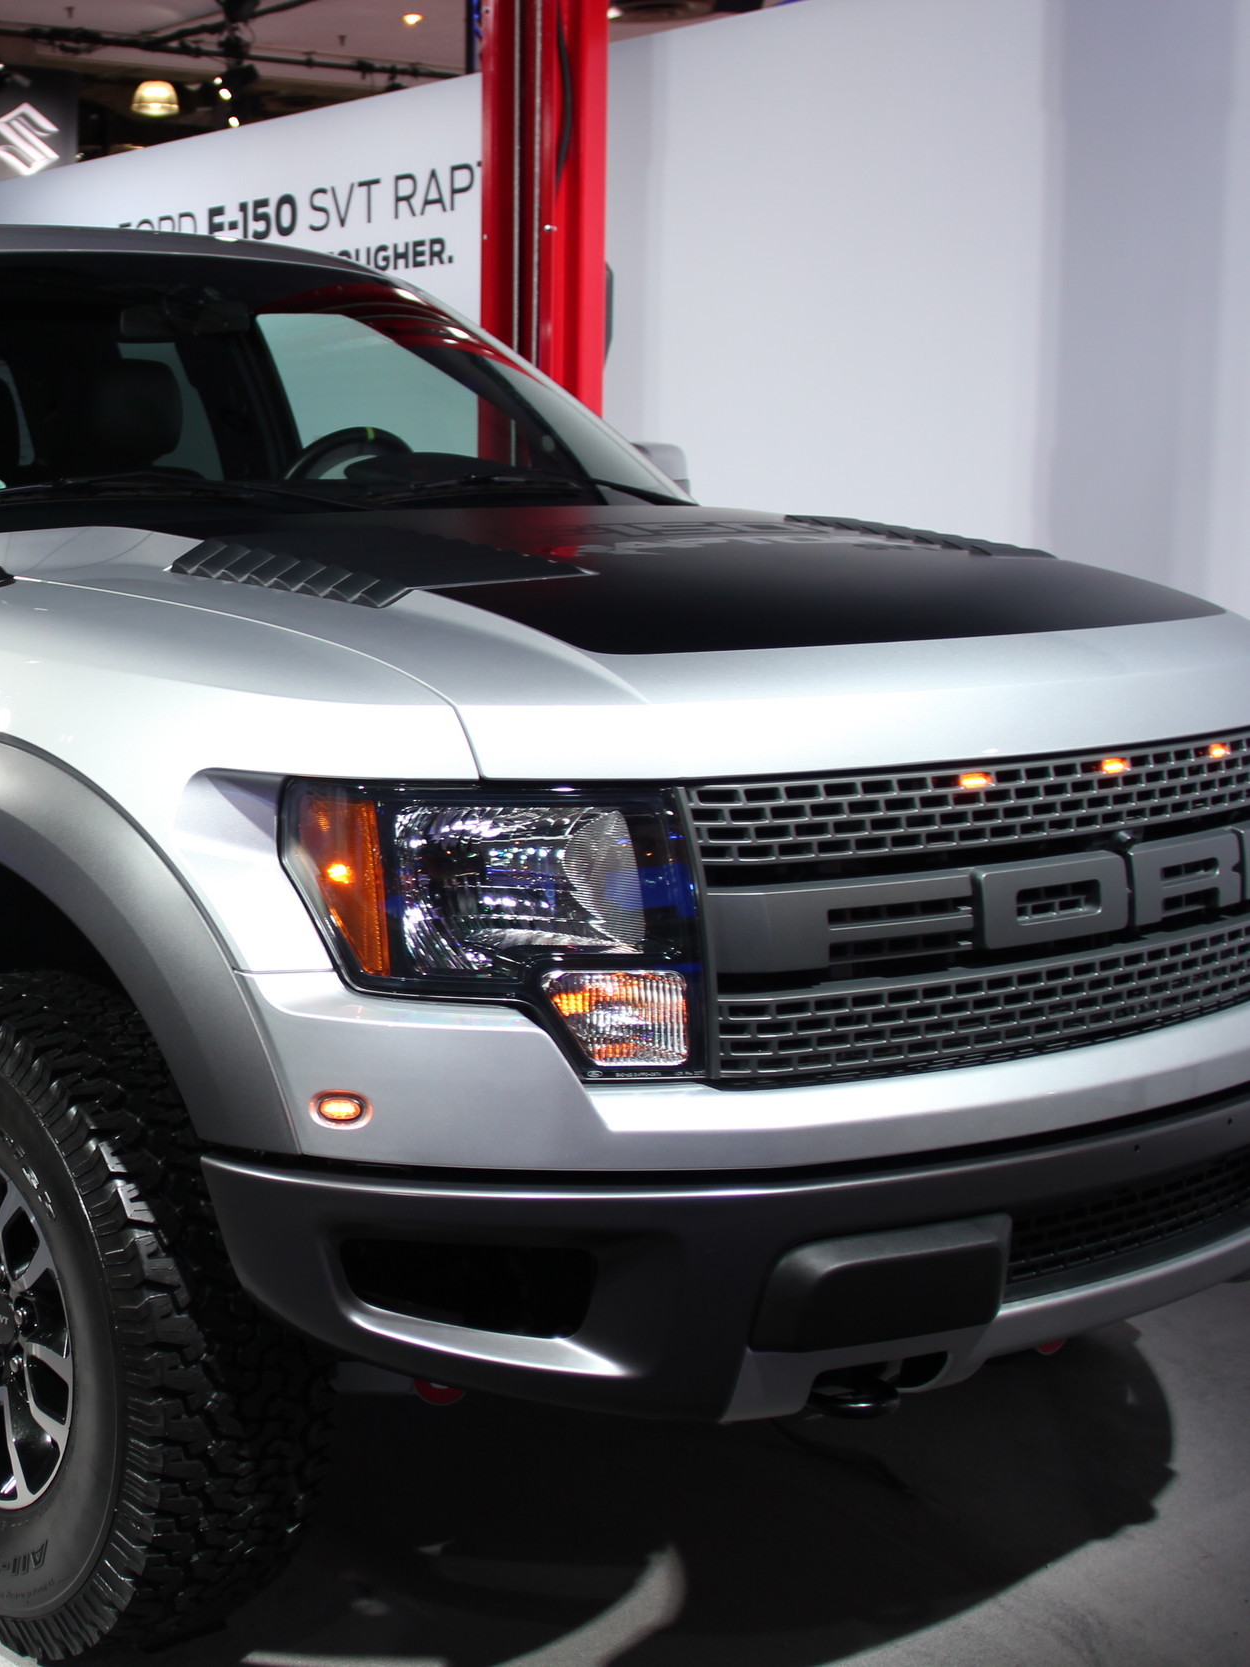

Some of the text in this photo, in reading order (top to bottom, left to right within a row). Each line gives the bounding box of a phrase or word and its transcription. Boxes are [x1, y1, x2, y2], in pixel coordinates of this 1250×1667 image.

[208, 193, 298, 241] F-150
[308, 178, 382, 232] SVT
[394, 161, 482, 220] RAP
[710, 821, 1250, 974] FOR
